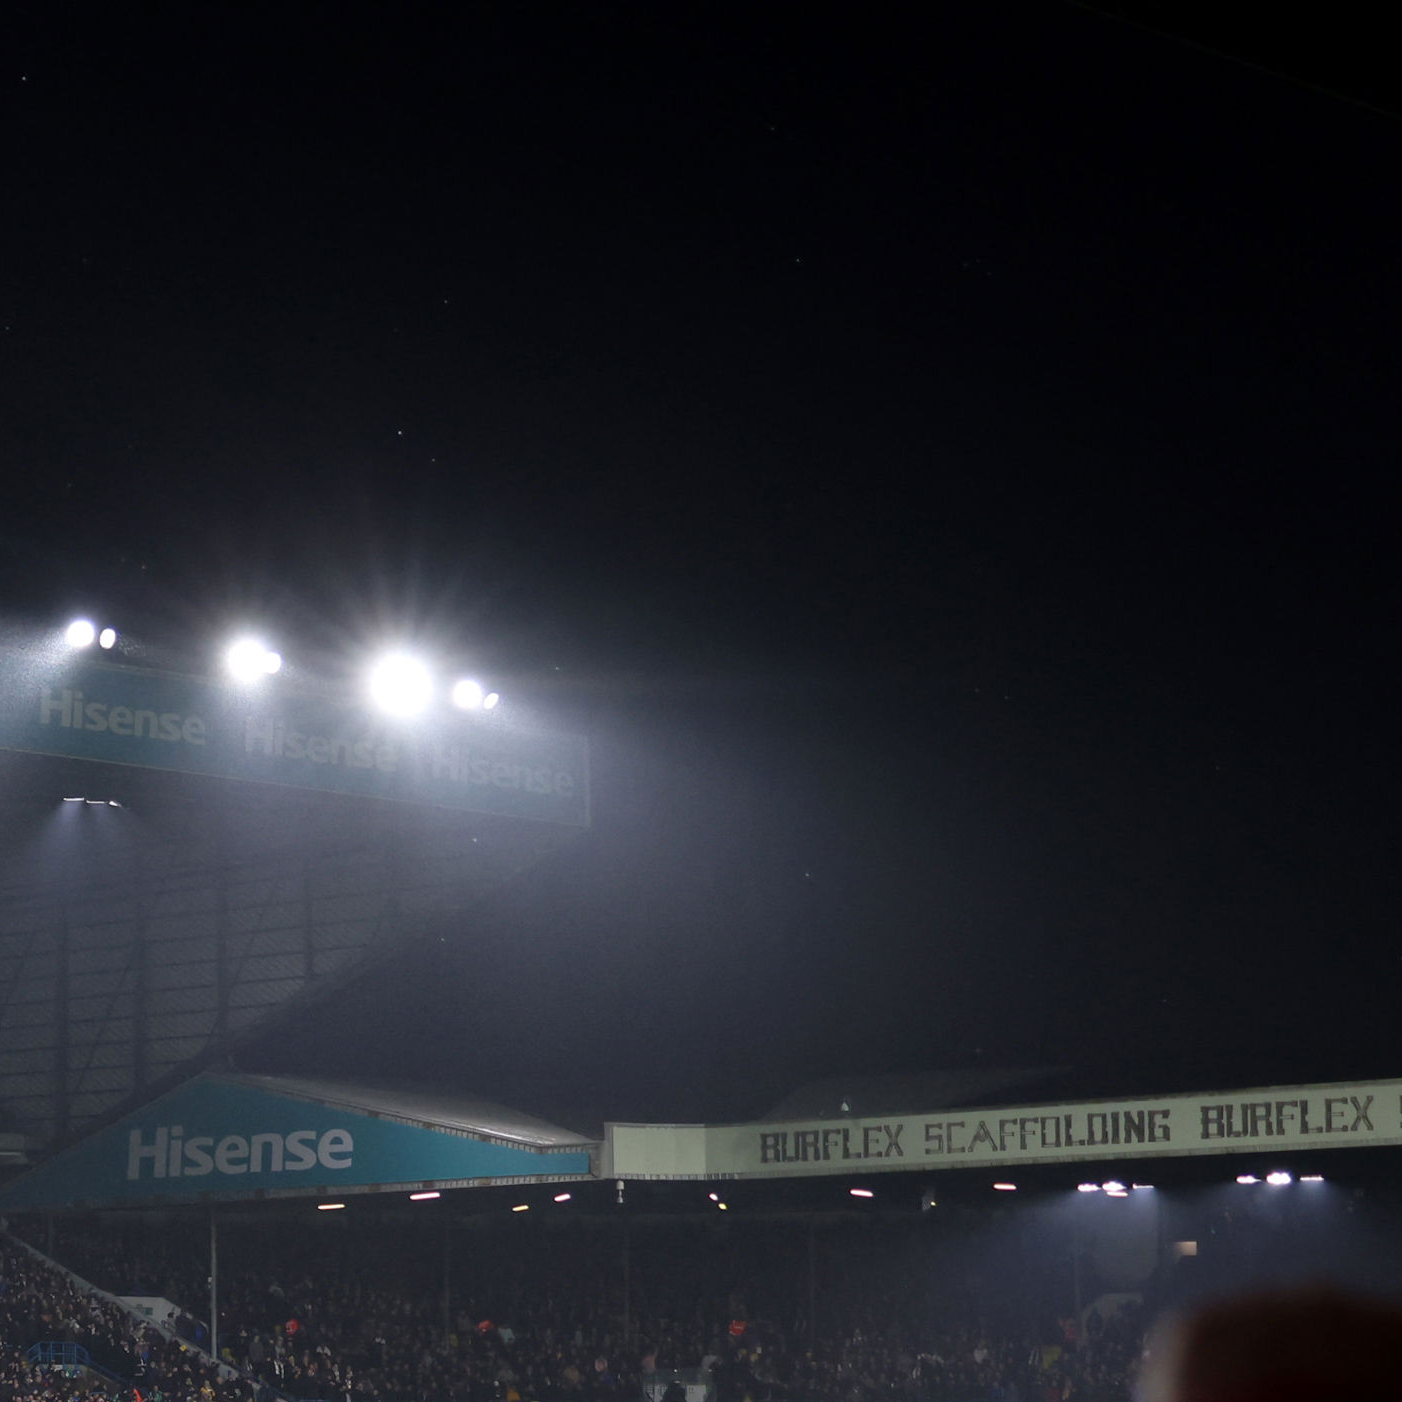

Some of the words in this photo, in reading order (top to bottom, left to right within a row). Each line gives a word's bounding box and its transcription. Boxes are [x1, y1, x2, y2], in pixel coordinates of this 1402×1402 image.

[38, 687, 207, 746] Hisense
[243, 716, 400, 772] Hisense
[431, 745, 575, 797] Hisense
[127, 1124, 354, 1181] Hisense
[760, 1123, 904, 1164] BURFLEX
[924, 1108, 1171, 1156] SCAFFOLDING
[1199, 1095, 1375, 1140] BURFLEX
